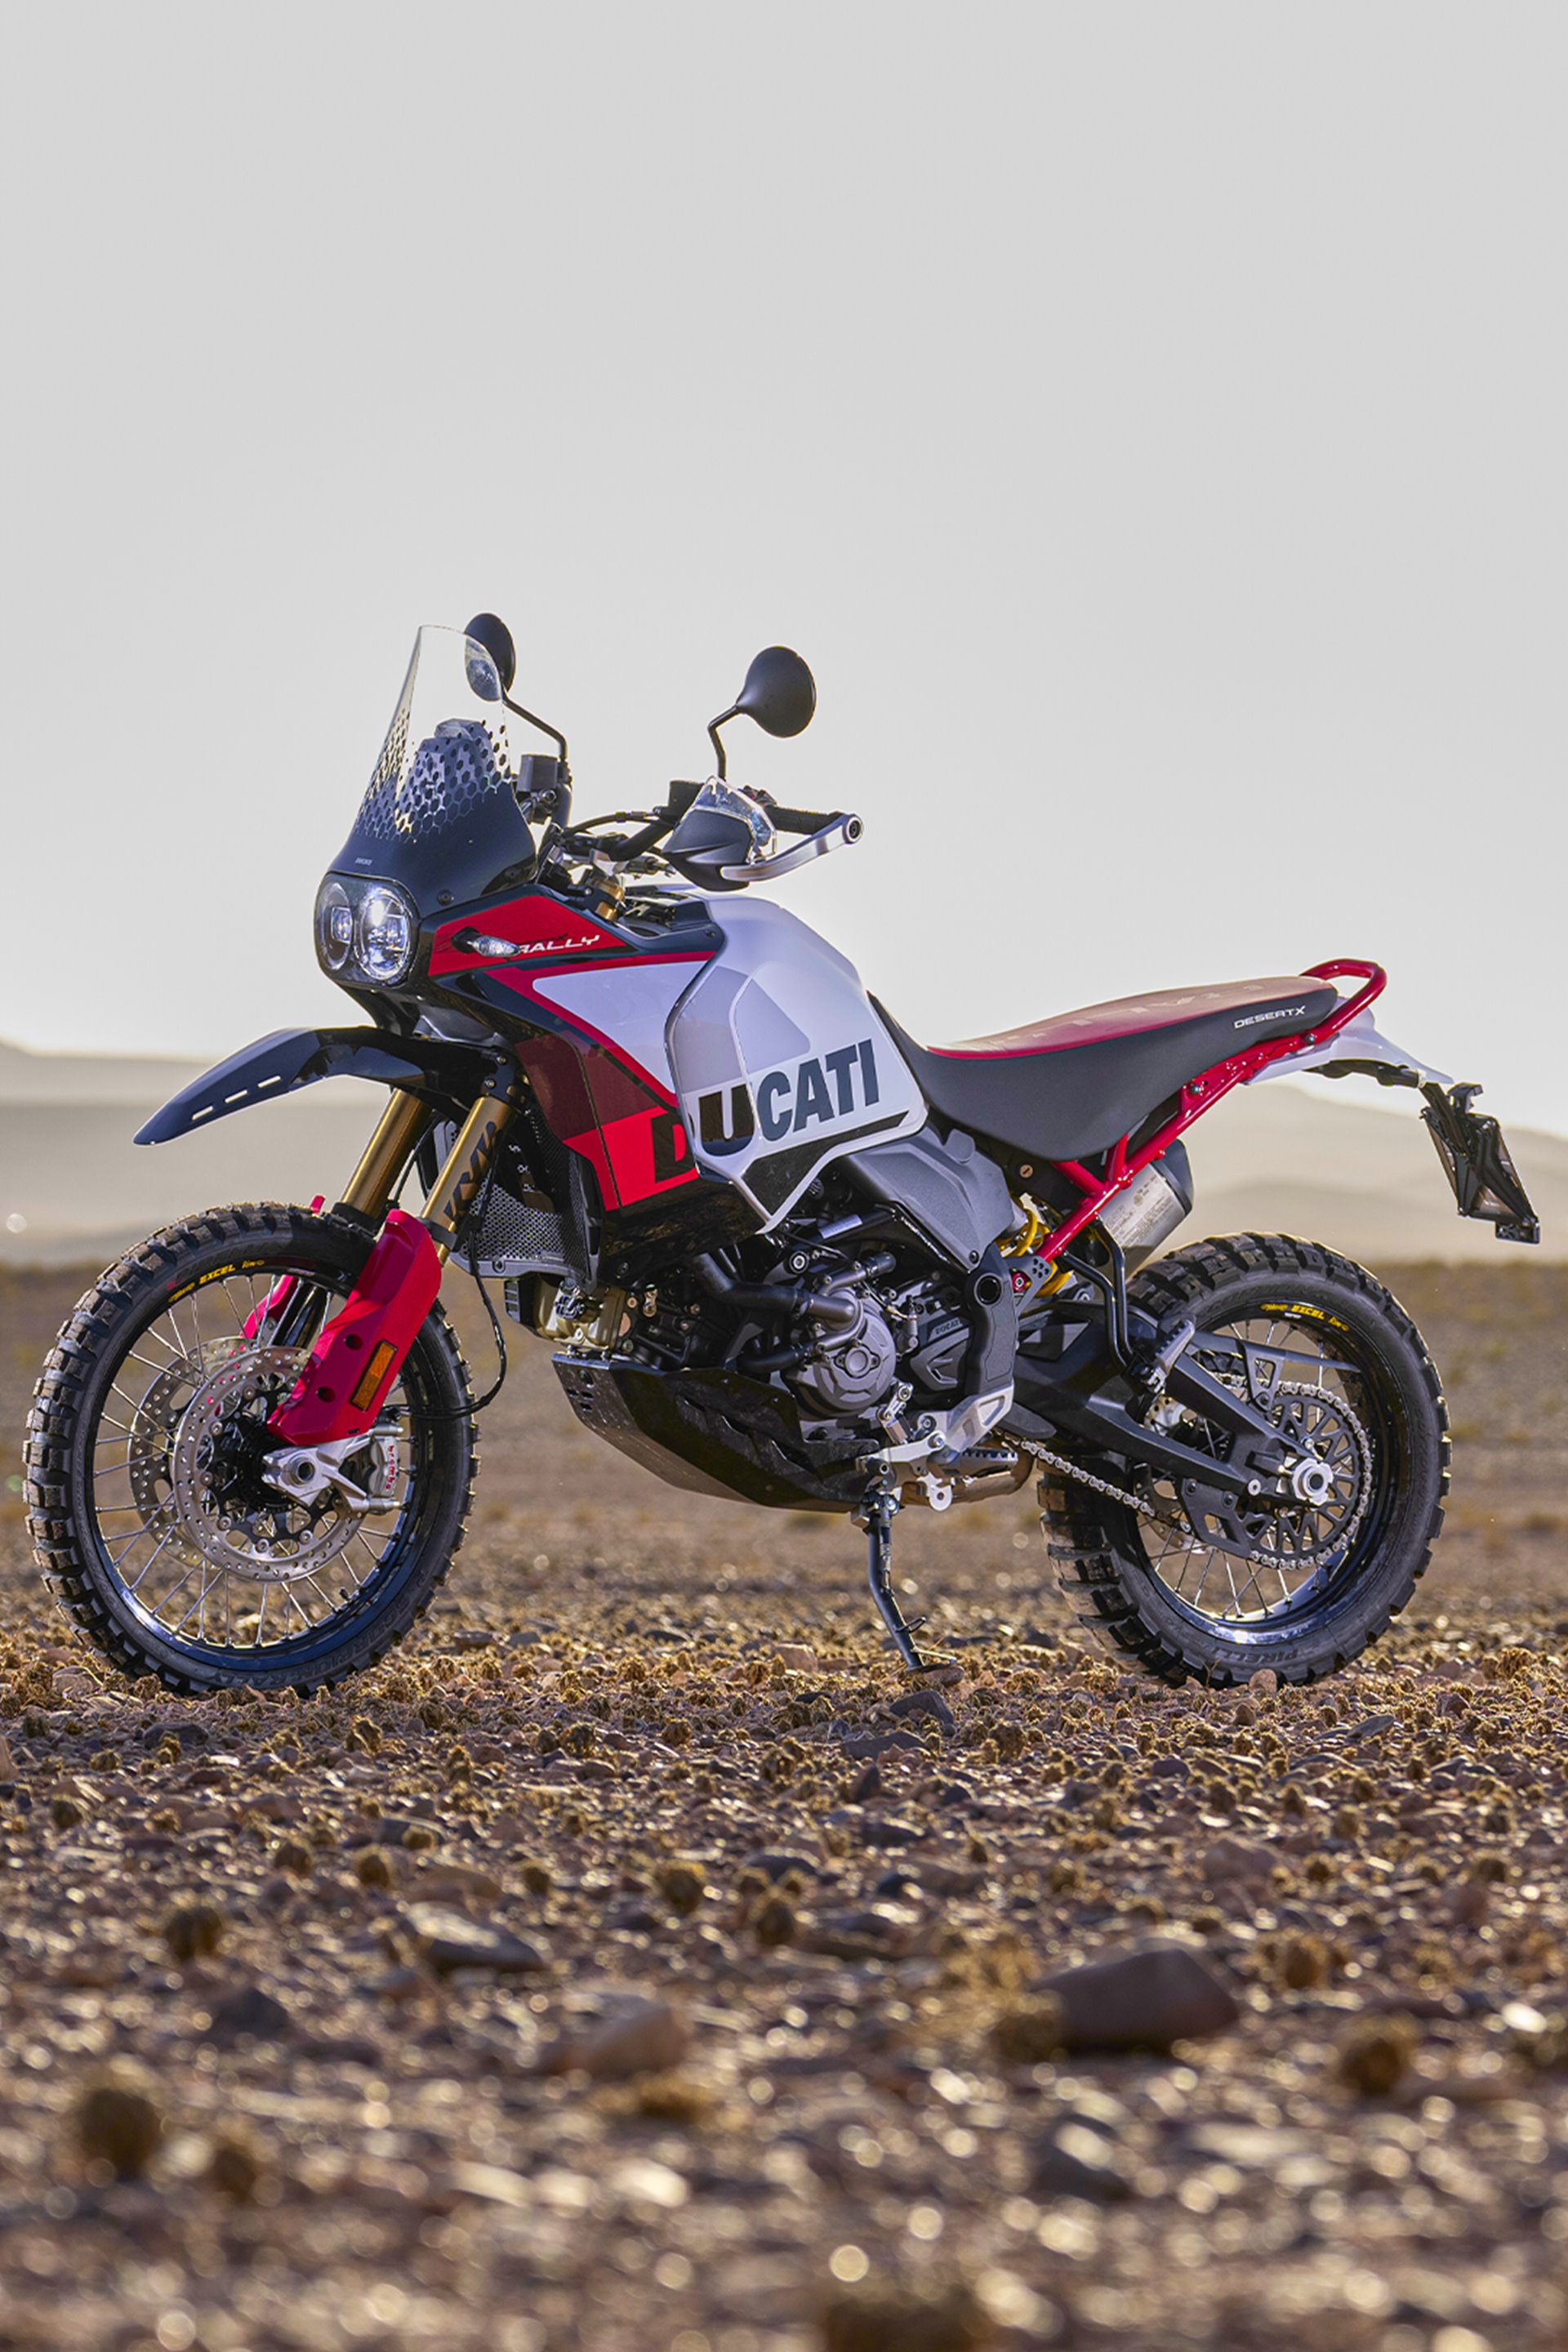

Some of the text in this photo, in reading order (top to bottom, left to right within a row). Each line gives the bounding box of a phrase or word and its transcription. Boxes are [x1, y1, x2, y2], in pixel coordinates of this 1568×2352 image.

[1234, 1004, 1306, 1029] DESERTX
[650, 1038, 880, 1183] DUCATI
[198, 1264, 236, 1285] EXCEL
[1290, 1304, 1325, 1320] EXCEL
